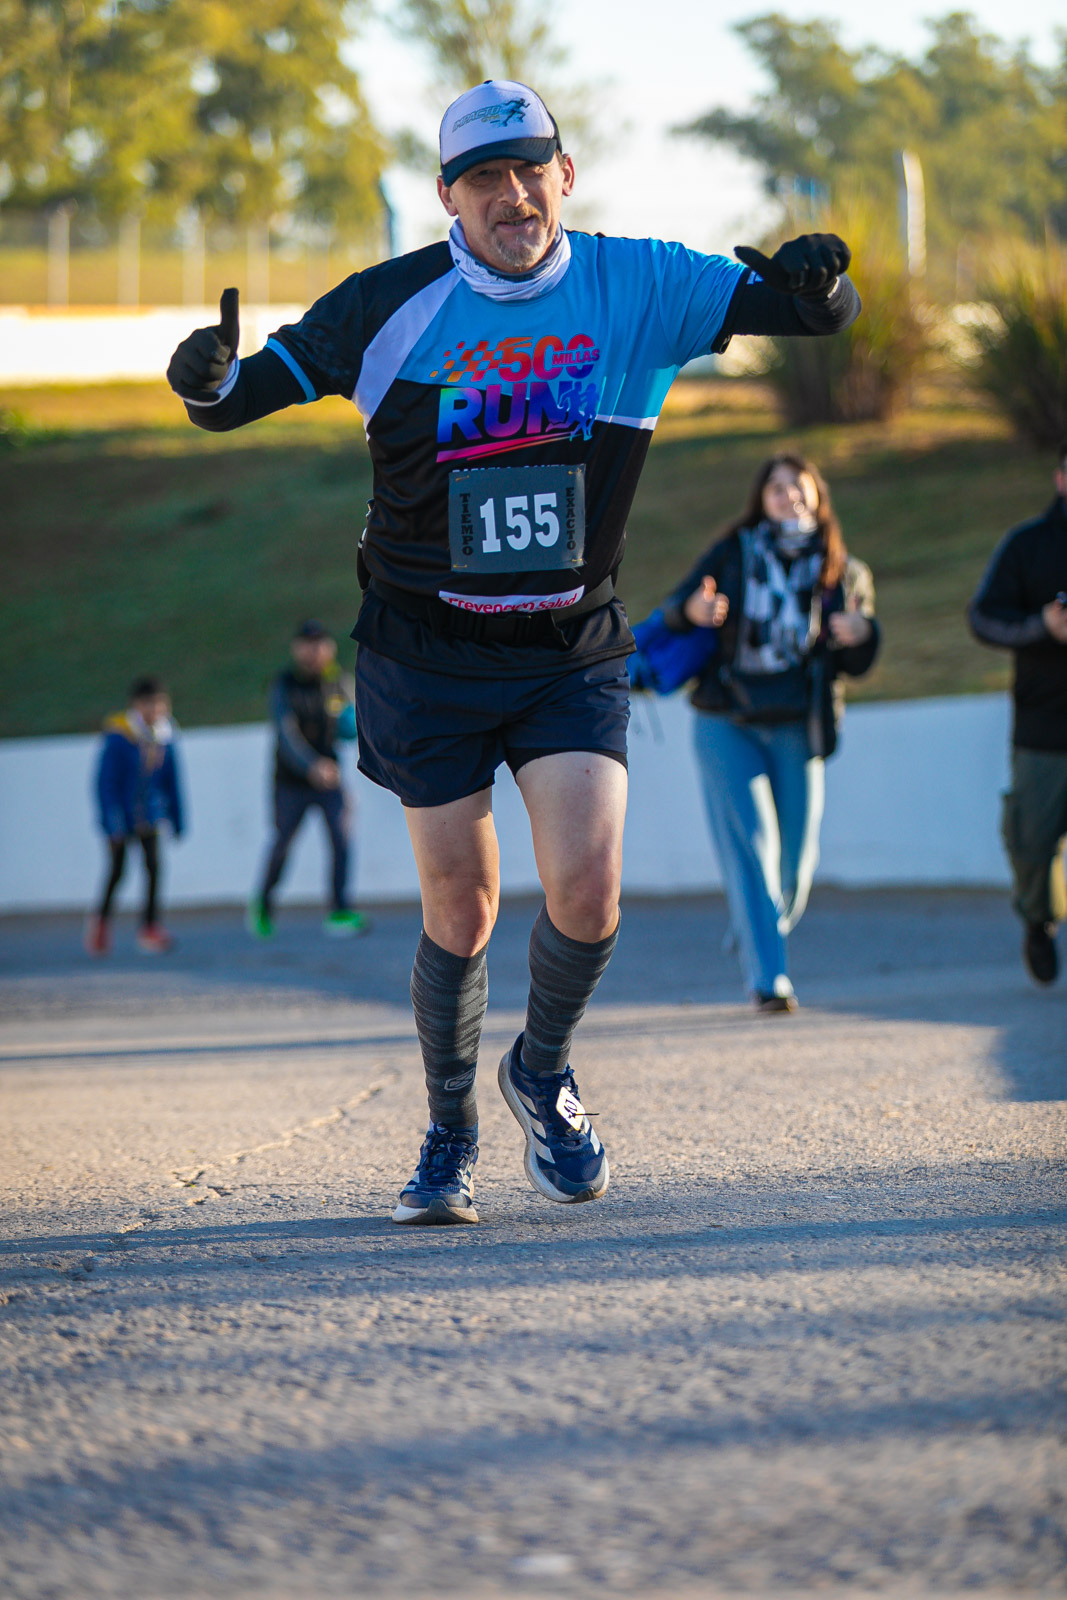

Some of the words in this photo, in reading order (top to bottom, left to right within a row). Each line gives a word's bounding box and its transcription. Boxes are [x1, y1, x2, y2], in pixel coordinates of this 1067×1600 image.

[498, 334, 595, 382] 500
[552, 349, 600, 366] MILLAS
[436, 380, 583, 444] RUN
[459, 493, 474, 556] TIEMPO
[479, 492, 560, 554] 155
[565, 487, 577, 551] EXACTO
